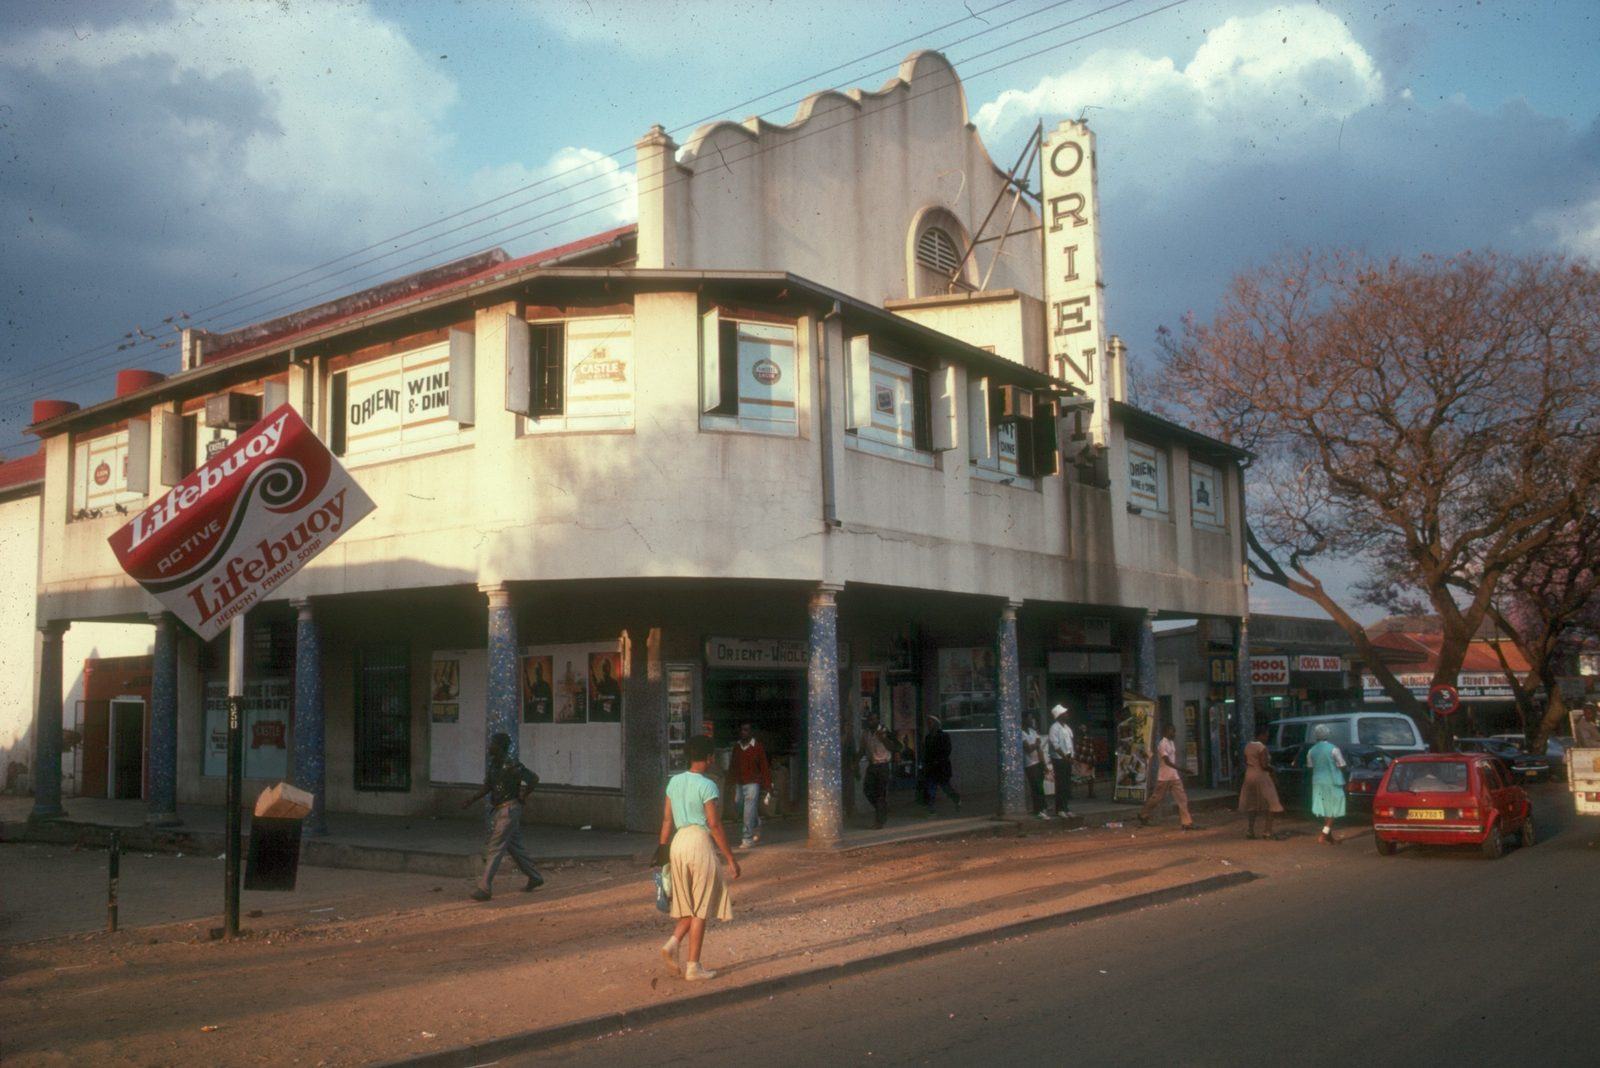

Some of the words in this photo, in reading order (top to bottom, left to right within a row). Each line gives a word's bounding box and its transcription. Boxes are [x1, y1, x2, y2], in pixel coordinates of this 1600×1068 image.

[1048, 140, 1095, 441] ORIENT
[350, 388, 400, 426] ORIENT
[127, 412, 289, 553] Lifebuoy
[1129, 461, 1157, 480] ORIENT
[157, 519, 221, 573] ACTIVE
[186, 487, 348, 626] Lifebuoy
[216, 592, 258, 626] HEALTHY
[261, 560, 295, 590] FAMILY
[297, 538, 322, 561] SOAP
[1251, 660, 1286, 670] HOOL
[1252, 673, 1286, 682] OOKS
